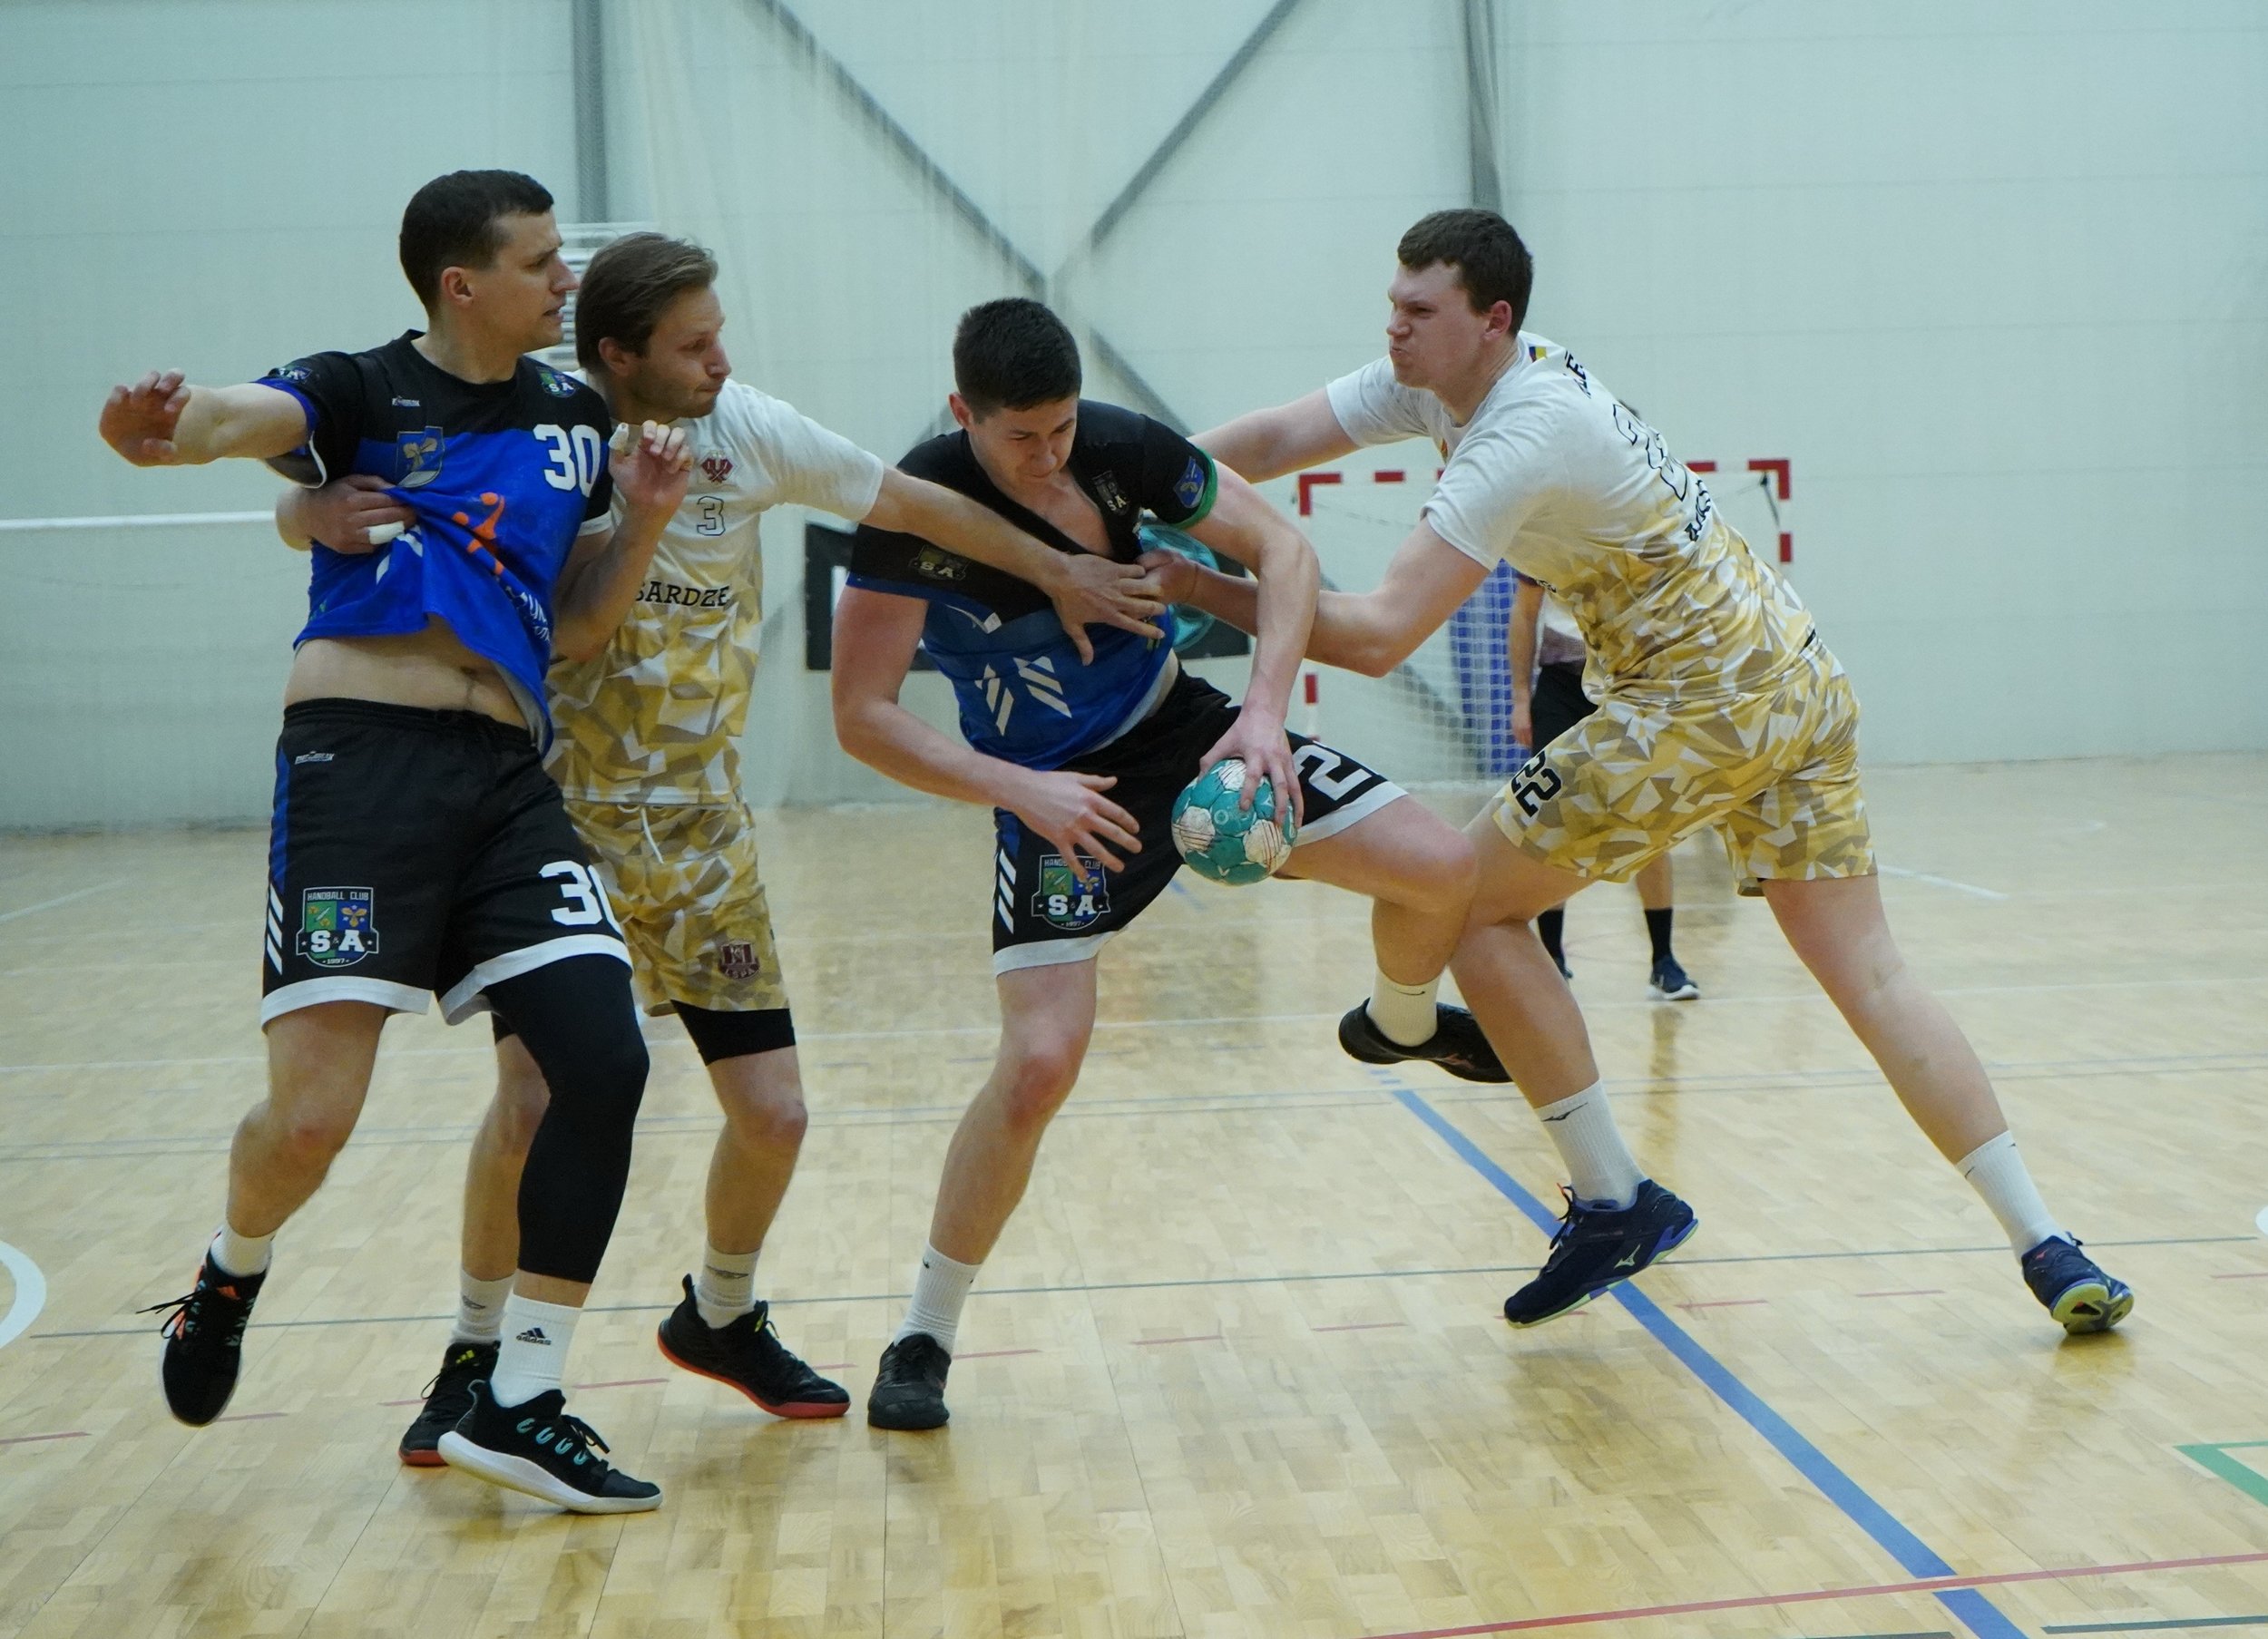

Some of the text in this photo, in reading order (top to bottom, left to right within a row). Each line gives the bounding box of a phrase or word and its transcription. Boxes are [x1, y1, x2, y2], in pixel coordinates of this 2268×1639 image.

[533, 424, 601, 498] 30
[697, 495, 726, 536] 3
[1511, 749, 1561, 818] 22
[307, 892, 369, 901] HANDBALL CLUB
[515, 1334, 552, 1346] adidas
